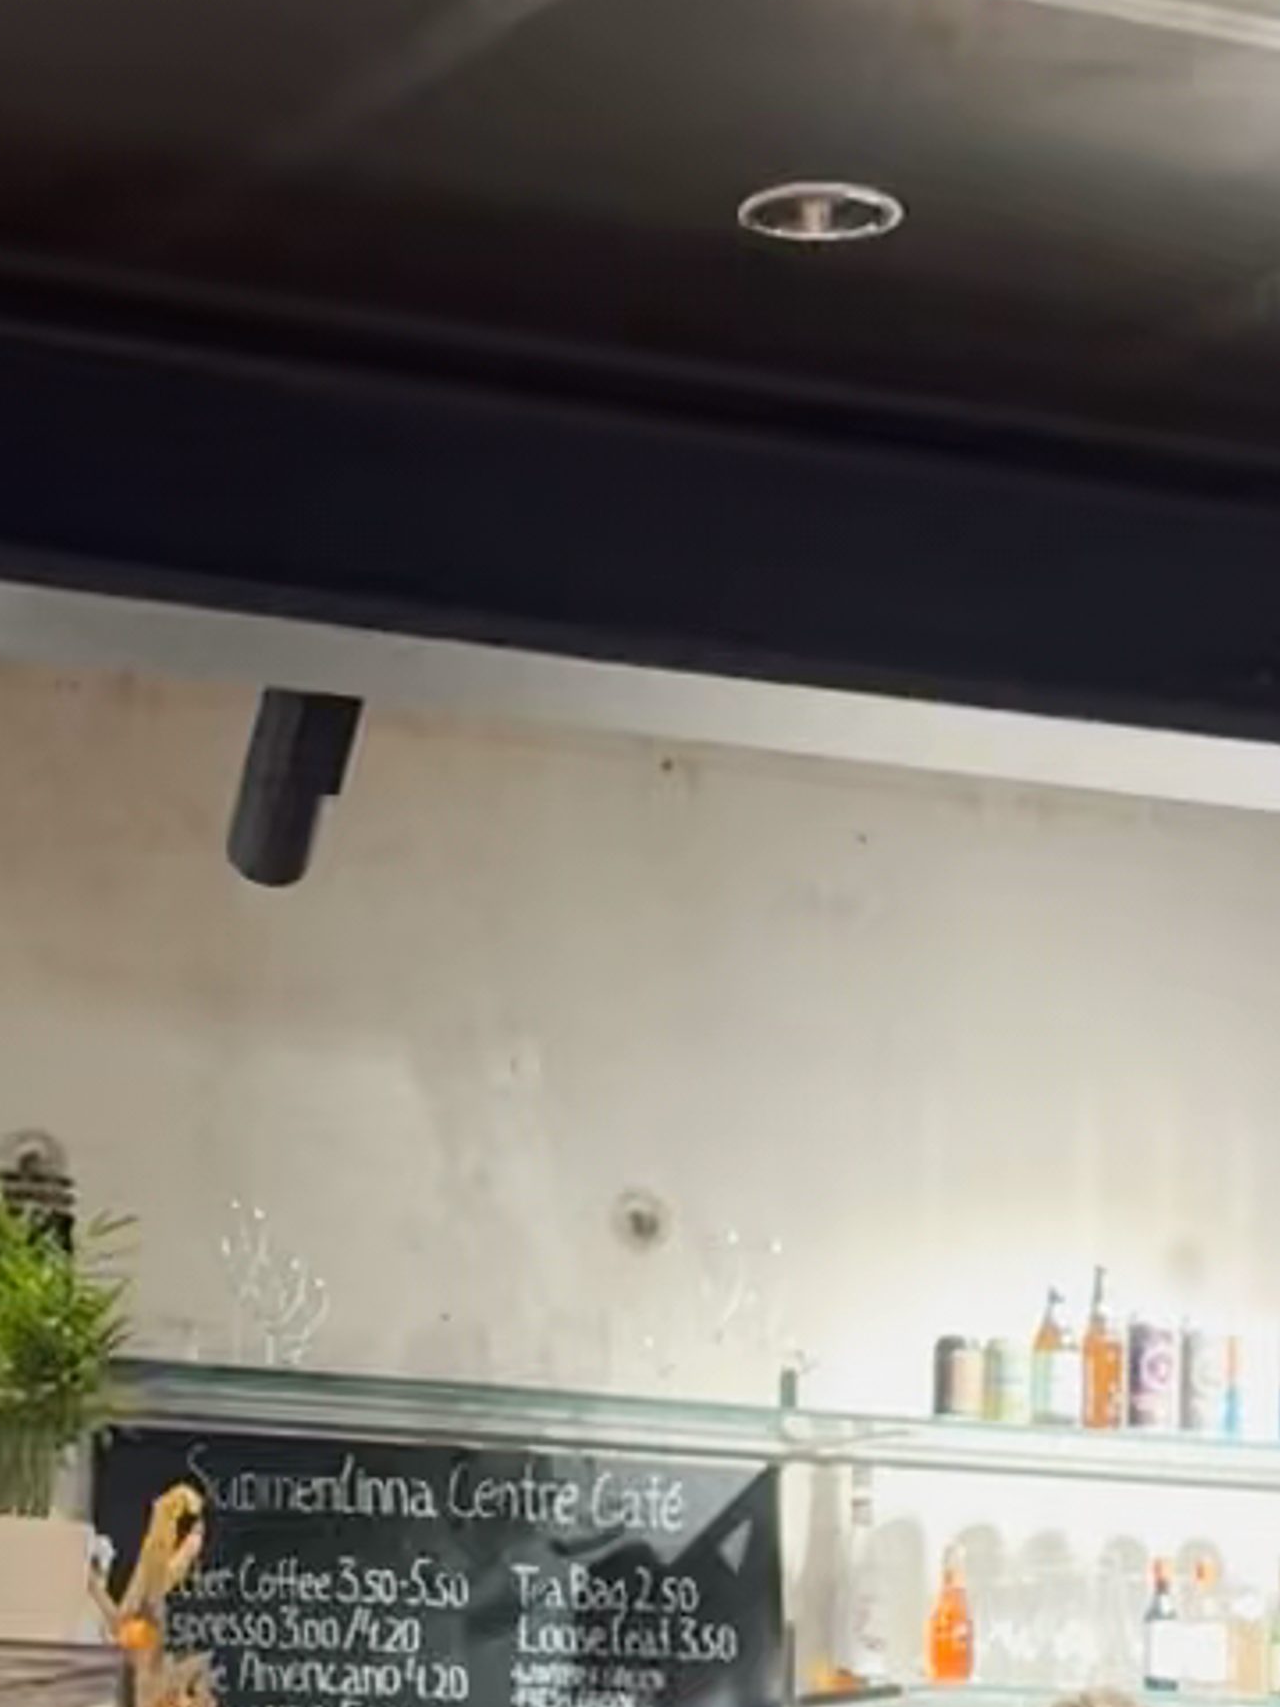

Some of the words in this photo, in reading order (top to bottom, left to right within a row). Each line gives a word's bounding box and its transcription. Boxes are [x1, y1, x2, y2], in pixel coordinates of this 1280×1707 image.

[447, 1460, 577, 1523] Centre
[239, 1553, 332, 1603] Coffee
[569, 1561, 629, 1620] Bag
[163, 1611, 276, 1652] spresso
[517, 1611, 609, 1657] Loose
[239, 1649, 402, 1696] Americano
